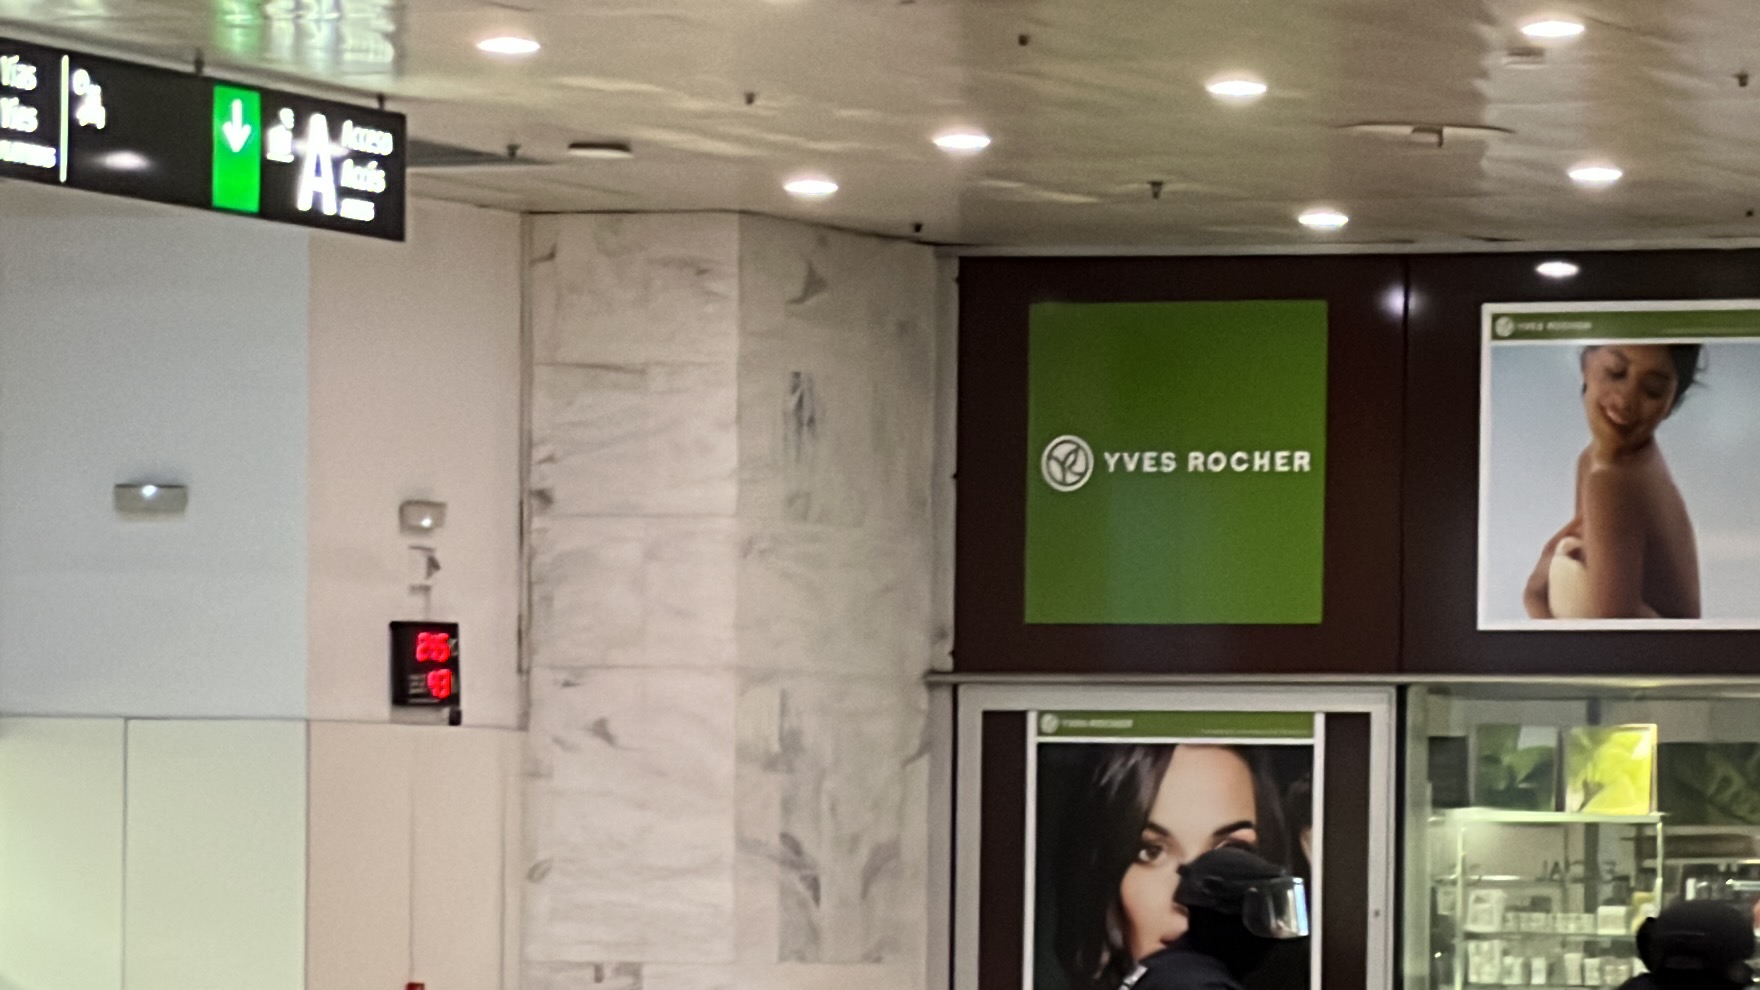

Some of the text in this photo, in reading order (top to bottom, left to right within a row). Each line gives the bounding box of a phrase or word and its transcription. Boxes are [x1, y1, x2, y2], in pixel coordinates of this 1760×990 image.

[297, 113, 337, 216] A
[1103, 450, 1312, 474] YVES ROCHER
